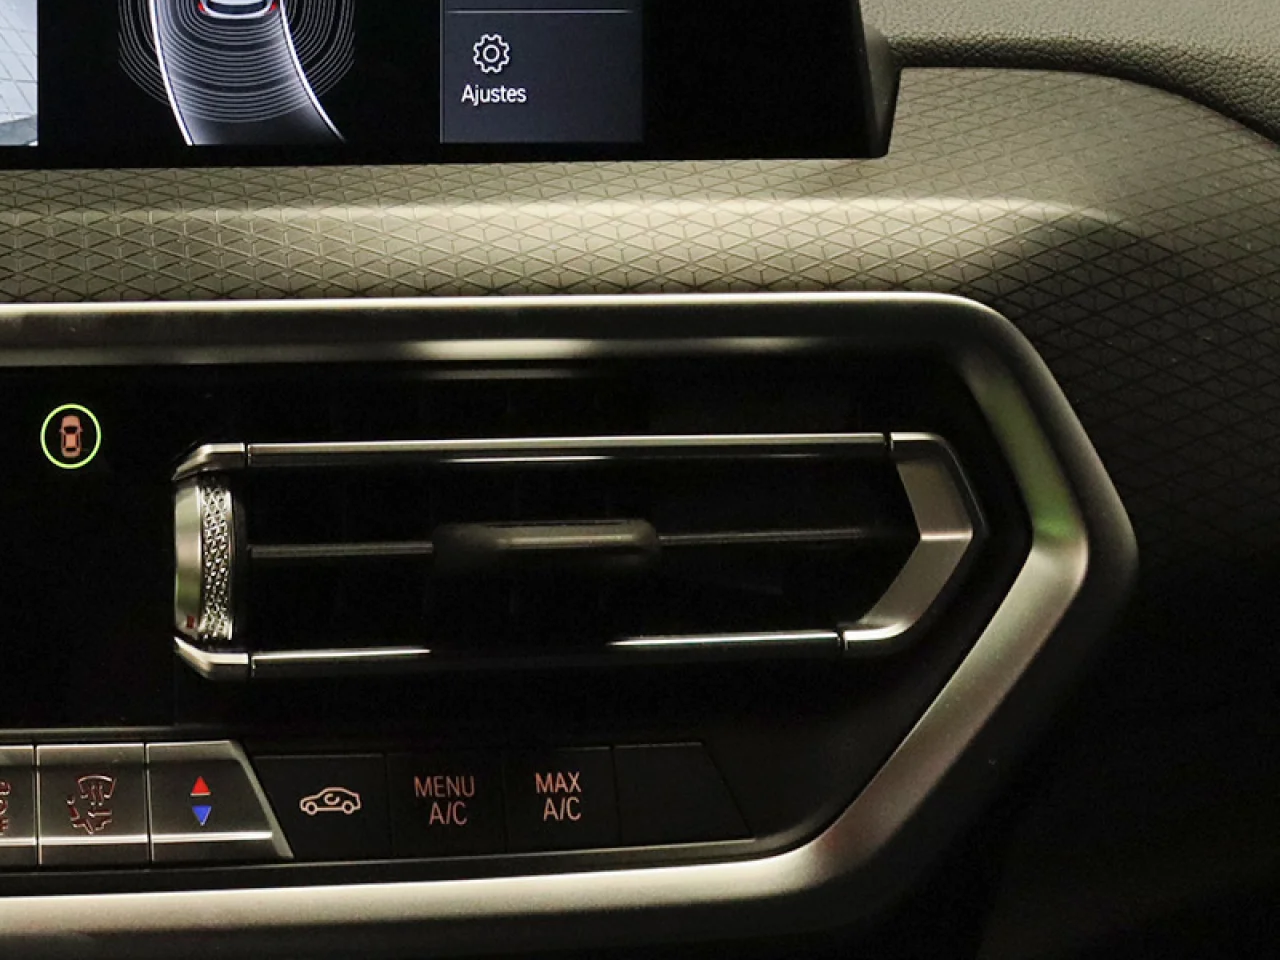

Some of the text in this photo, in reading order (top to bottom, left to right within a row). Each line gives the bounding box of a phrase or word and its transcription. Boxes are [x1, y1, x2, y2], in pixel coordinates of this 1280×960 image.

[461, 84, 527, 106] Ajustes
[413, 775, 476, 798] MENU
[535, 771, 582, 793] MAX
[429, 801, 468, 826] A/C
[543, 797, 582, 821] A/C
